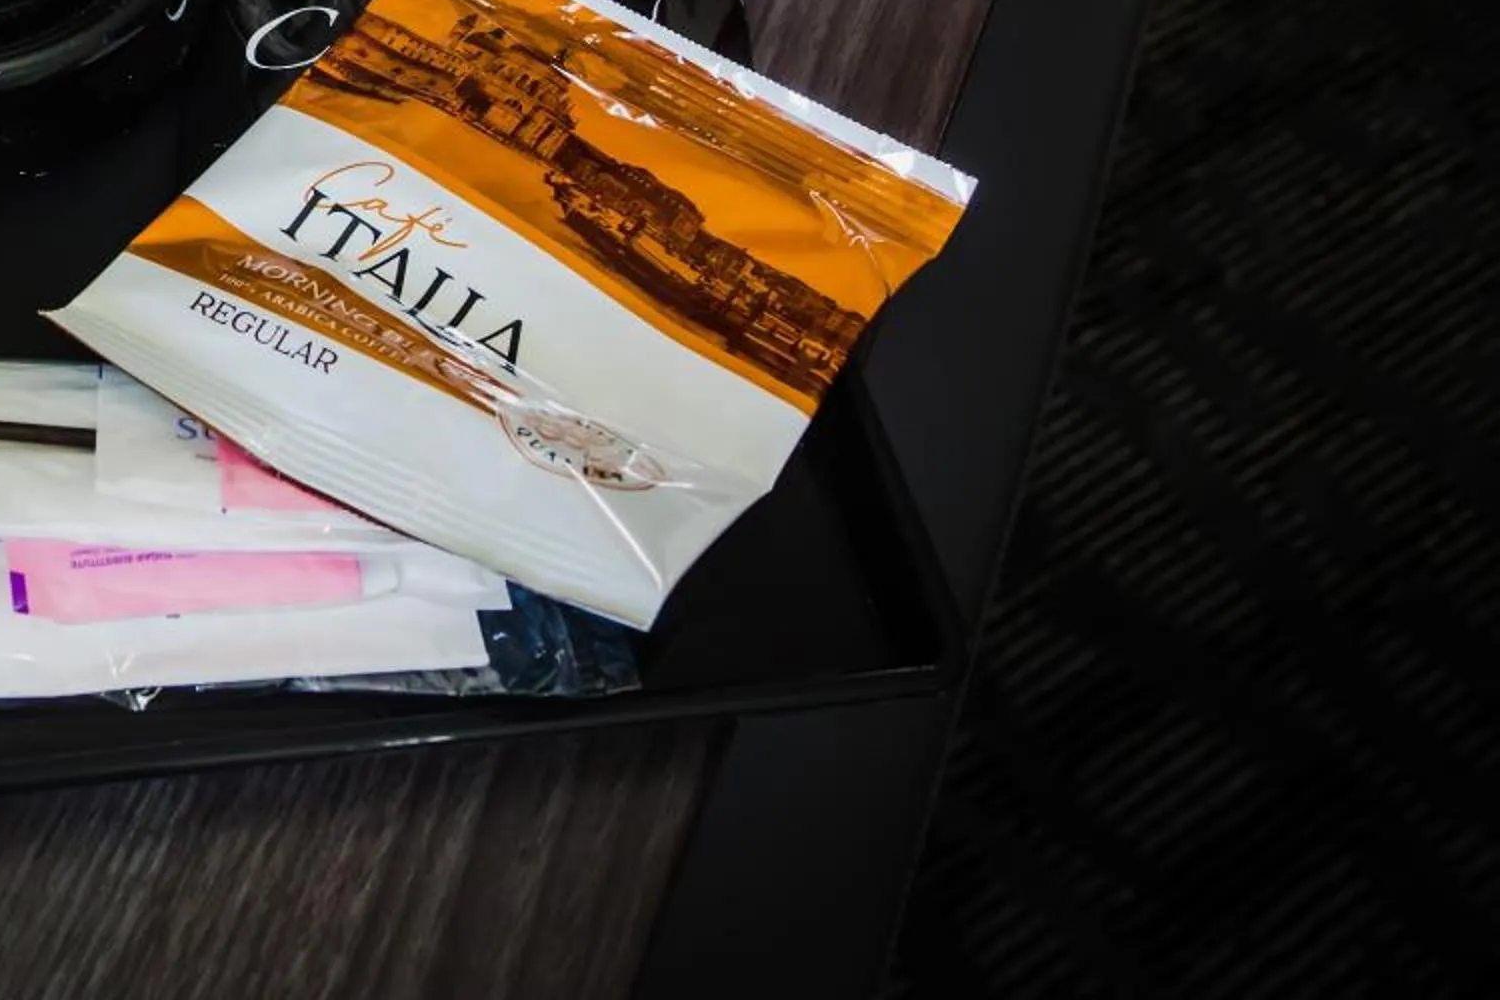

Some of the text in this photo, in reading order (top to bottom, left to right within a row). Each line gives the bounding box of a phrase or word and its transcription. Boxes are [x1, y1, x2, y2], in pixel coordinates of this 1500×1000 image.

[304, 161, 469, 261] Café
[236, 253, 380, 330] MORNING
[261, 289, 338, 331] ARABICA
[188, 290, 340, 374] REGULAR
